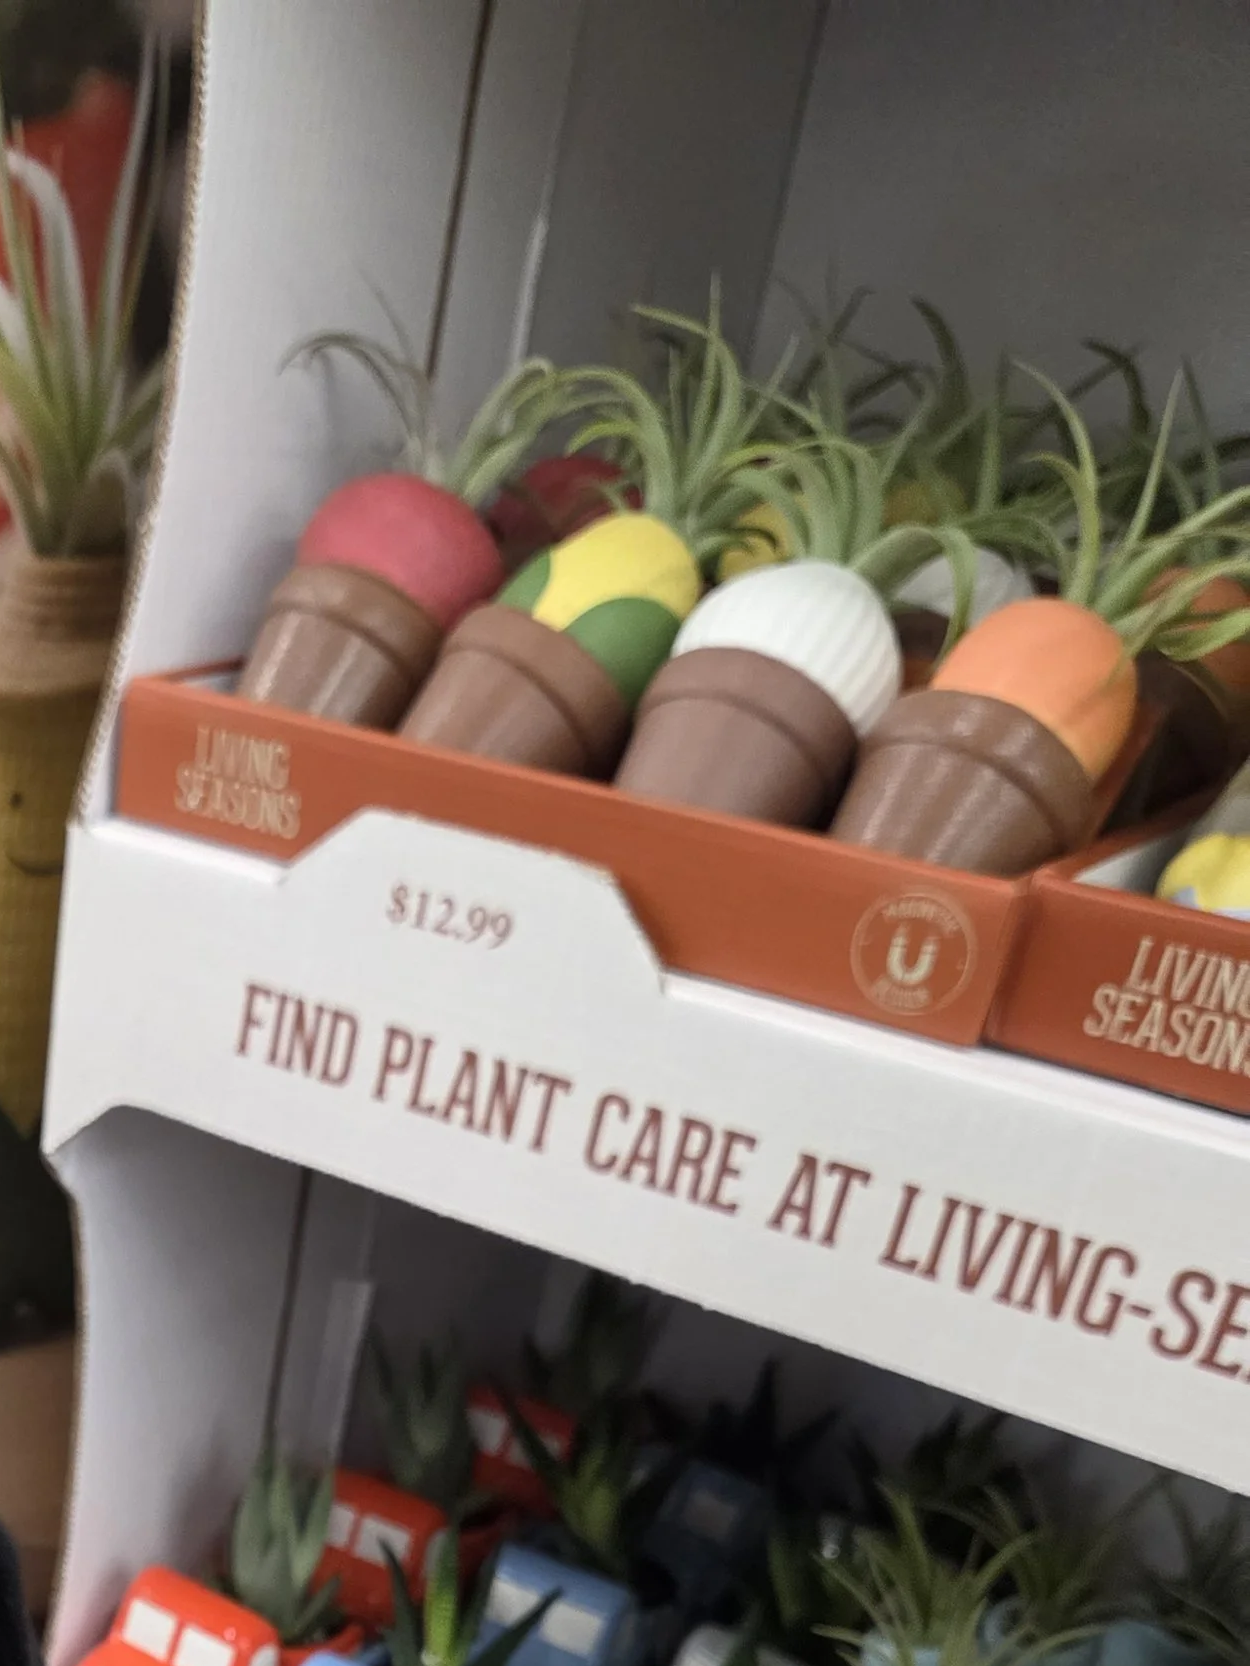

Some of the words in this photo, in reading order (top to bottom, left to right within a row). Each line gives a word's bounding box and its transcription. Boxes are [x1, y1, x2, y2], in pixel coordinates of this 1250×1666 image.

[386, 882, 514, 949] $12.99
[234, 982, 360, 1088] FIND
[371, 1024, 572, 1154] PLANT
[583, 1090, 757, 1216] CARE
[765, 1152, 872, 1250] AT
[878, 1183, 1250, 1385] LIVING-SE
